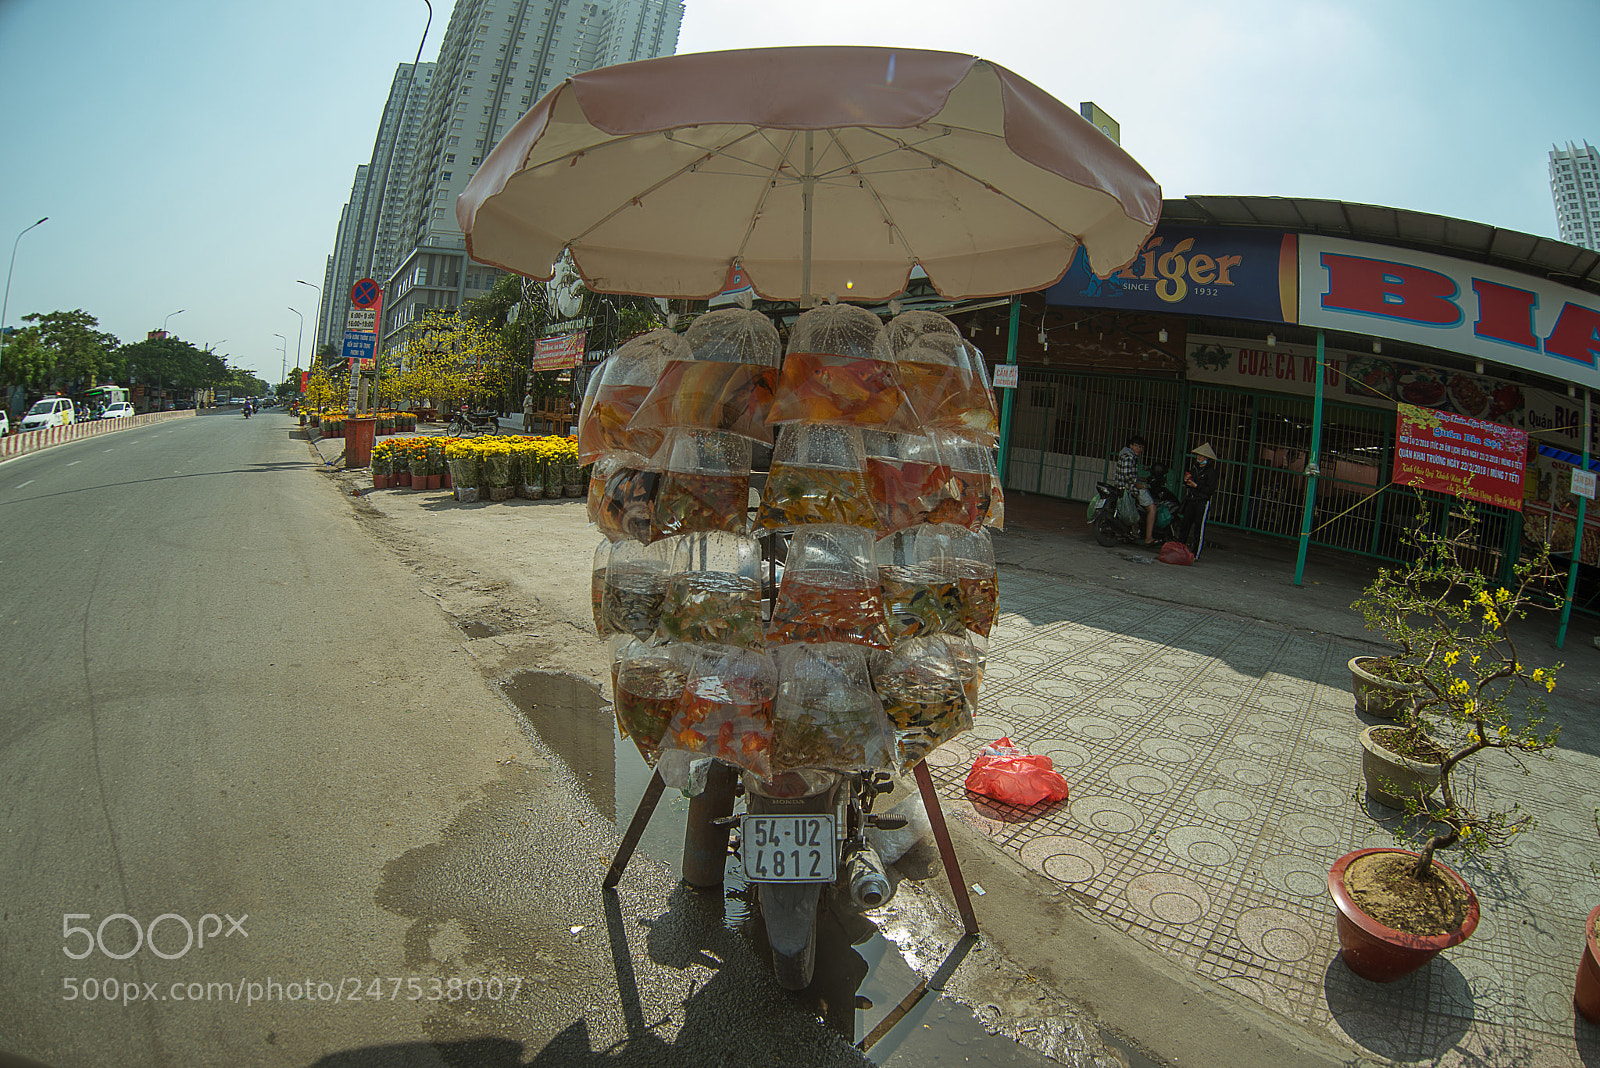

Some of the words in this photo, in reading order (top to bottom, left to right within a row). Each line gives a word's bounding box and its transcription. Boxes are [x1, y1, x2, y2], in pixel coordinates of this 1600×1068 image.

[1117, 236, 1243, 304] iger
[1122, 282, 1150, 292] SINCE
[1194, 287, 1219, 297] 1932
[1238, 349, 1269, 378] CUA
[1275, 348, 1296, 381] CÀ
[1528, 410, 1553, 430] Quán
[1433, 427, 1462, 441] Quán
[1464, 433, 1481, 444] Bia
[1398, 444, 1413, 460] QUÁN
[1413, 450, 1426, 461] KHAI
[1446, 455, 1460, 469] NGÀY
[755, 819, 821, 847] 54-U2
[755, 849, 822, 878] 4812
